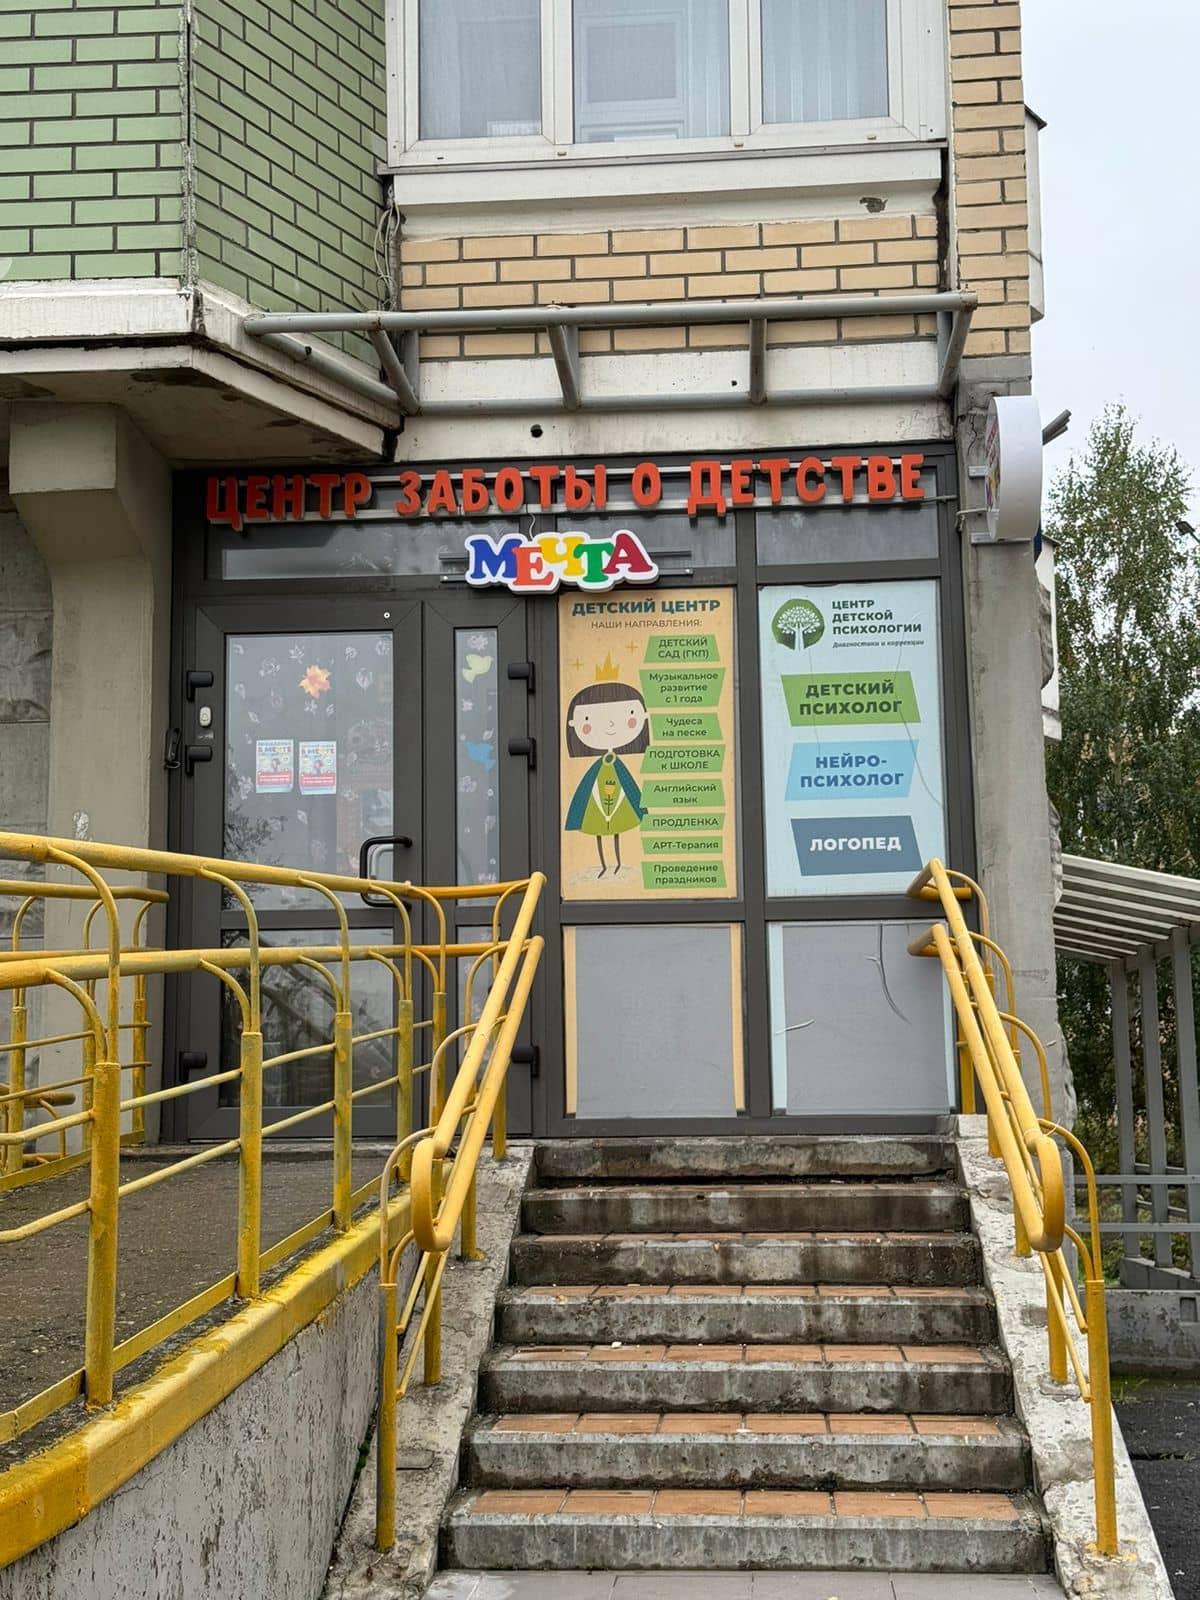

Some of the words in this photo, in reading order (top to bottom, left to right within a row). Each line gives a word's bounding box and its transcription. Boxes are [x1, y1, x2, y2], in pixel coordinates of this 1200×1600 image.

[206, 473, 372, 531] ЦЕНТР
[395, 464, 608, 517] ЗАБОТЫ
[630, 462, 663, 508] О
[687, 453, 926, 518] ДЕТСТВЕ
[469, 533, 653, 586] МЕЧТА
[572, 599, 656, 617] ДЕТСКИЙ
[661, 600, 721, 614] ЦЕНТР
[832, 600, 875, 610] ЦЕНТР
[832, 610, 893, 623] ДЕТСКОЙ
[591, 620, 622, 629] НАШИ
[624, 618, 703, 628] НАПРАВЛЕНИЯ:
[832, 624, 922, 635] ПСИХОЛОГИИ
[658, 636, 708, 648] ДЕТСКИЙ
[658, 650, 680, 658] САД
[683, 649, 709, 659] (ГКП)
[649, 673, 719, 682] Музыкальное
[660, 685, 708, 693] развитие
[805, 680, 894, 699] ДЕТСКИЙ
[680, 695, 703, 703] года
[800, 701, 902, 716] ПСИХОЛОГ
[666, 718, 702, 727] Чудеса
[649, 749, 720, 759] ПОДГОТОВКА
[670, 761, 709, 770] ШКОЛЕ
[815, 753, 887, 769] НЕЙРО-
[800, 773, 904, 788] ПСИХОЛОГ
[653, 783, 717, 793] Английский
[652, 818, 719, 828] ПРОДЛЕНКА
[652, 841, 719, 850] АРТ-Терапия
[810, 837, 902, 851] ЛОГОПЕД
[653, 864, 719, 873] Проведение
[655, 876, 717, 885] праздников
